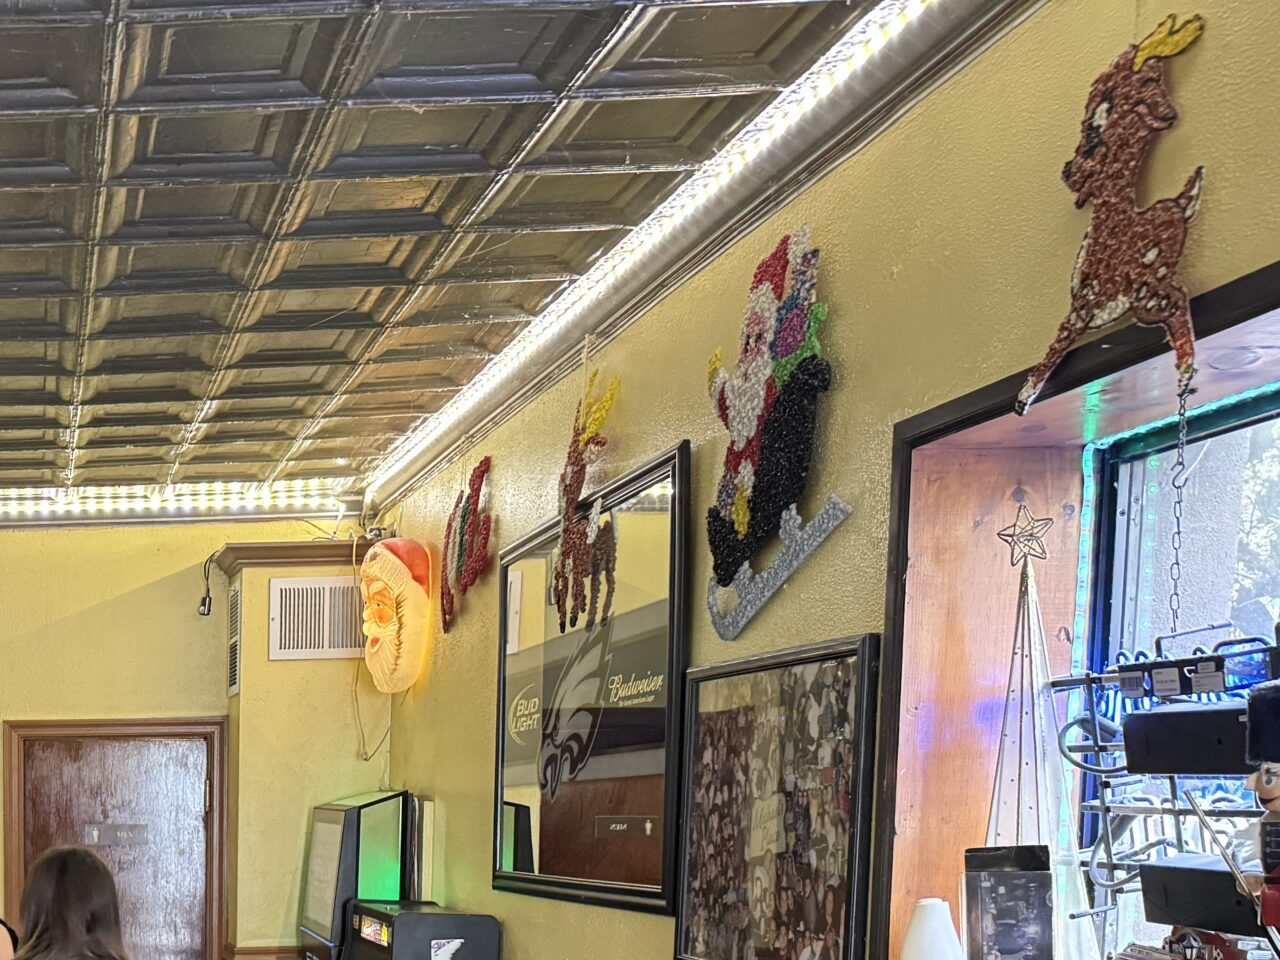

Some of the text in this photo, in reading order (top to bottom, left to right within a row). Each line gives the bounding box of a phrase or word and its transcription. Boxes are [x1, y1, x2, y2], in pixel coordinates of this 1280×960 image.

[608, 670, 664, 703] Budweiser
[516, 697, 539, 717] BUD
[511, 712, 541, 733] LIGHT
